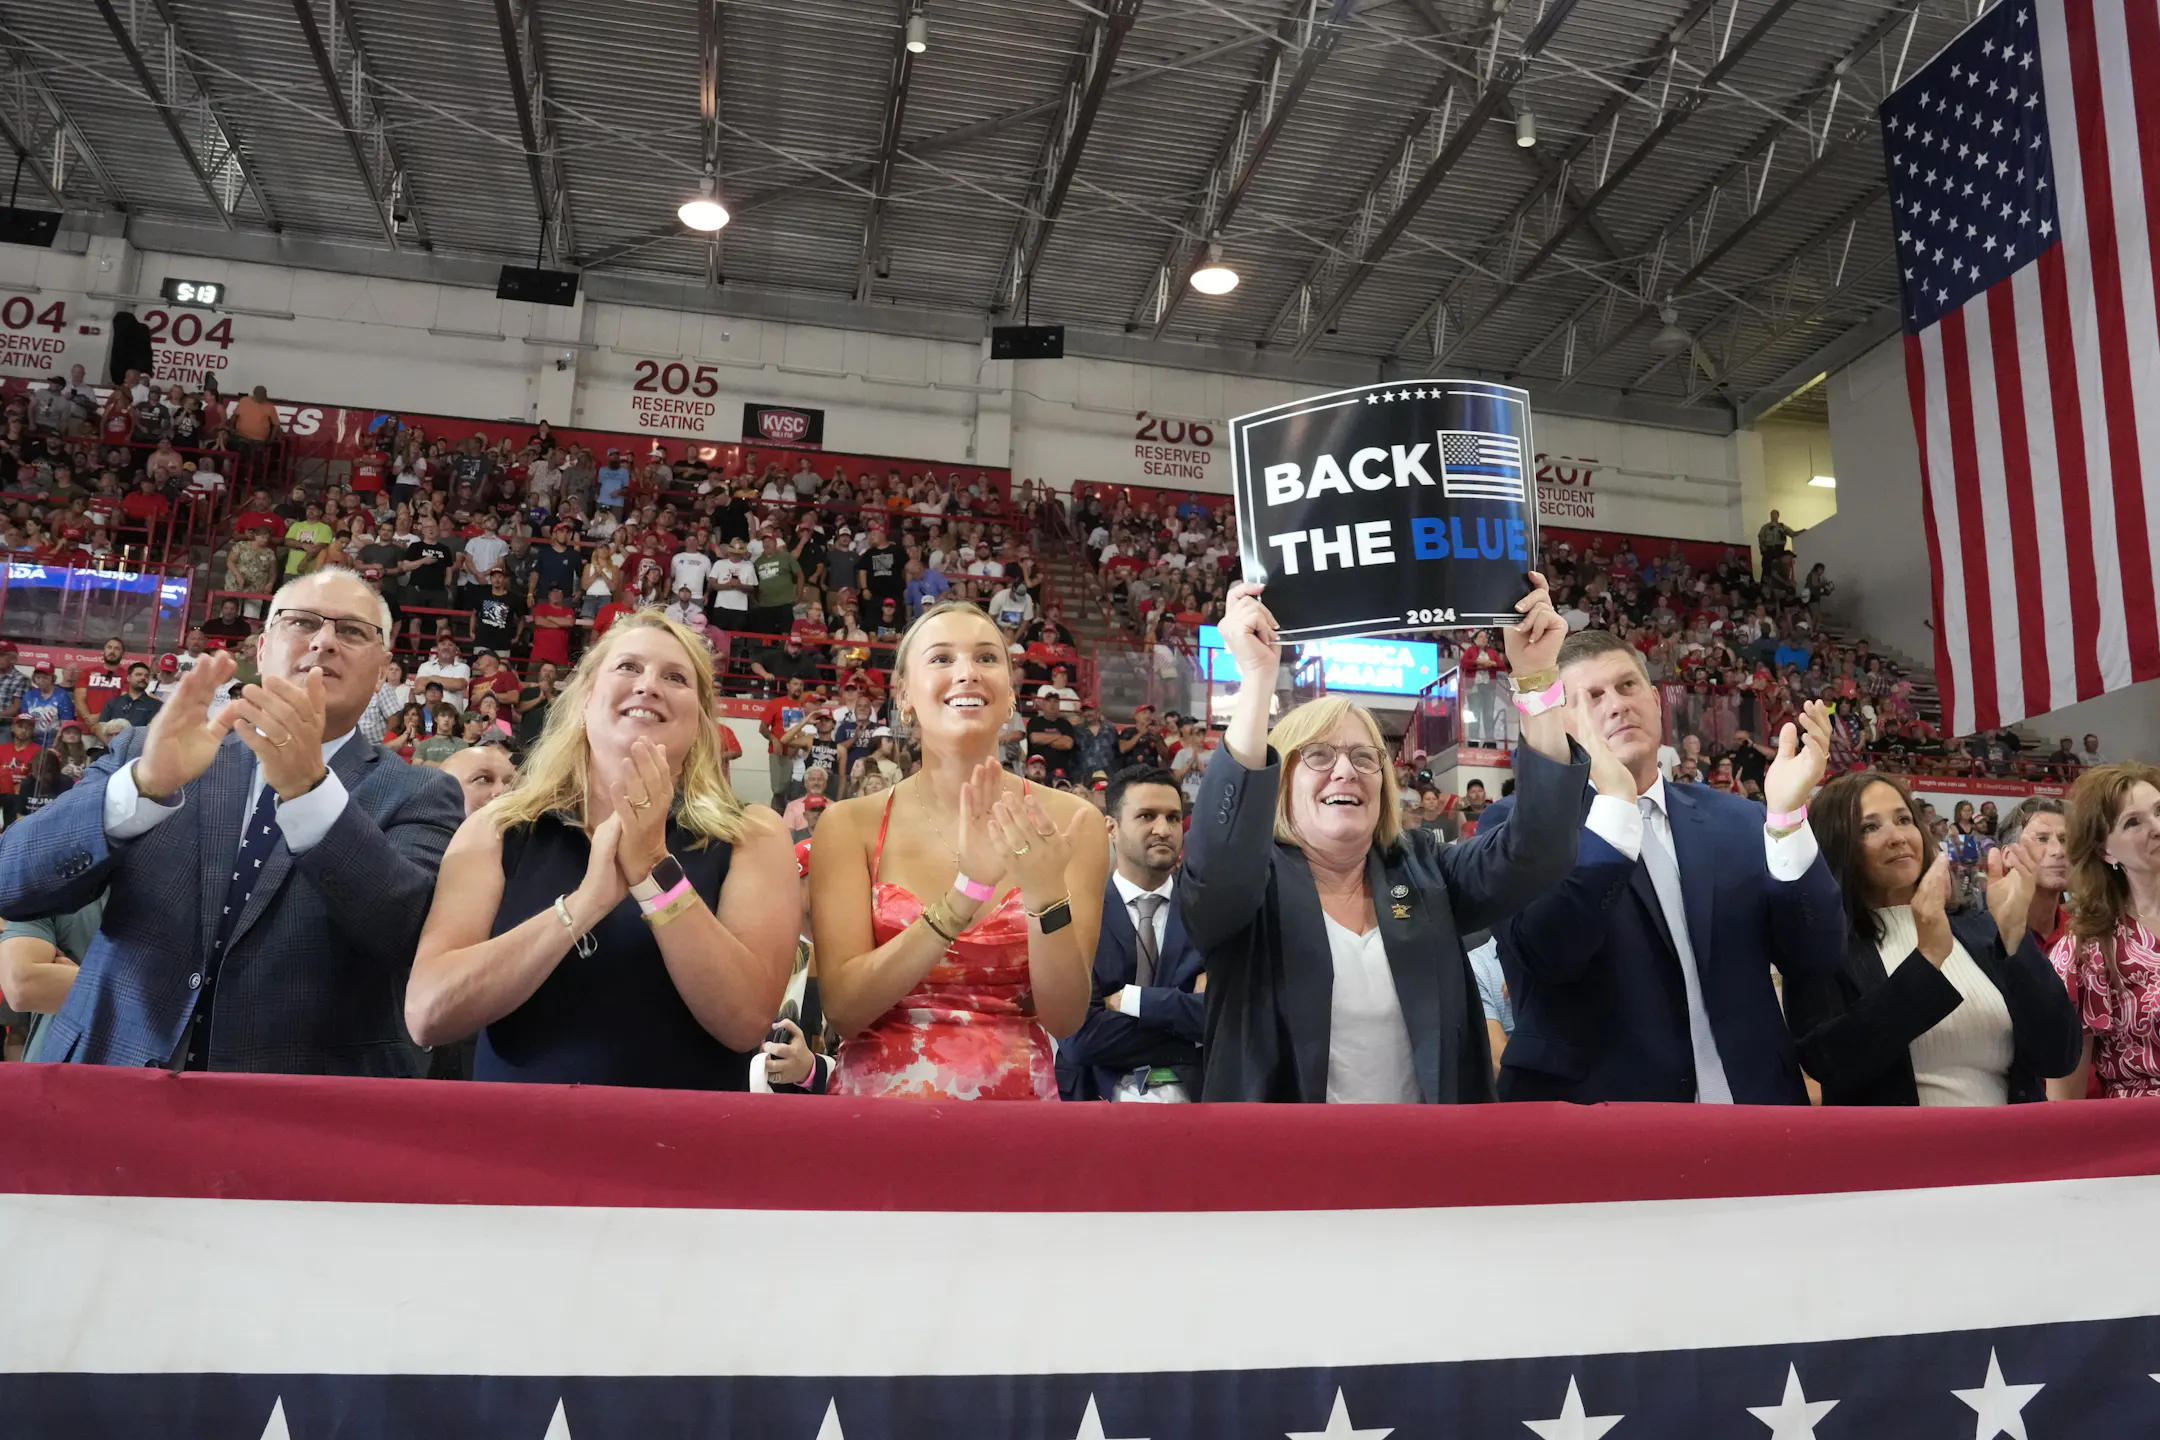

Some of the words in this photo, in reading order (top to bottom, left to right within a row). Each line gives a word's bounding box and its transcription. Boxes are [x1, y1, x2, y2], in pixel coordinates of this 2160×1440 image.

[177, 282, 217, 304] 5:13
[2, 296, 67, 333] 04
[144, 309, 235, 350] 204
[0, 334, 65, 354] SERVED
[0, 351, 53, 369] ATING
[152, 349, 228, 370] ESERVED
[633, 360, 719, 398] 205
[632, 396, 716, 417] RESERVED
[639, 413, 705, 431] SEATING
[763, 414, 804, 432] KVSC
[1135, 410, 1214, 447] 206
[1135, 445, 1211, 465] RESERVED
[1143, 461, 1204, 479] SEATING
[1264, 443, 1437, 507] BACK
[1535, 453, 1599, 486] 207
[1538, 487, 1595, 504] STUDENT
[1540, 501, 1595, 518] SECTION
[1268, 519, 1396, 576] THE
[1411, 517, 1528, 561] BLUE
[1406, 608, 1457, 624] 2024
[76, 655, 104, 664] Cloud/C
[1303, 641, 1415, 668] AMERICA
[89, 675, 121, 689] USA
[1324, 663, 1403, 688] AGAIN
[813, 759, 832, 769] 2024
